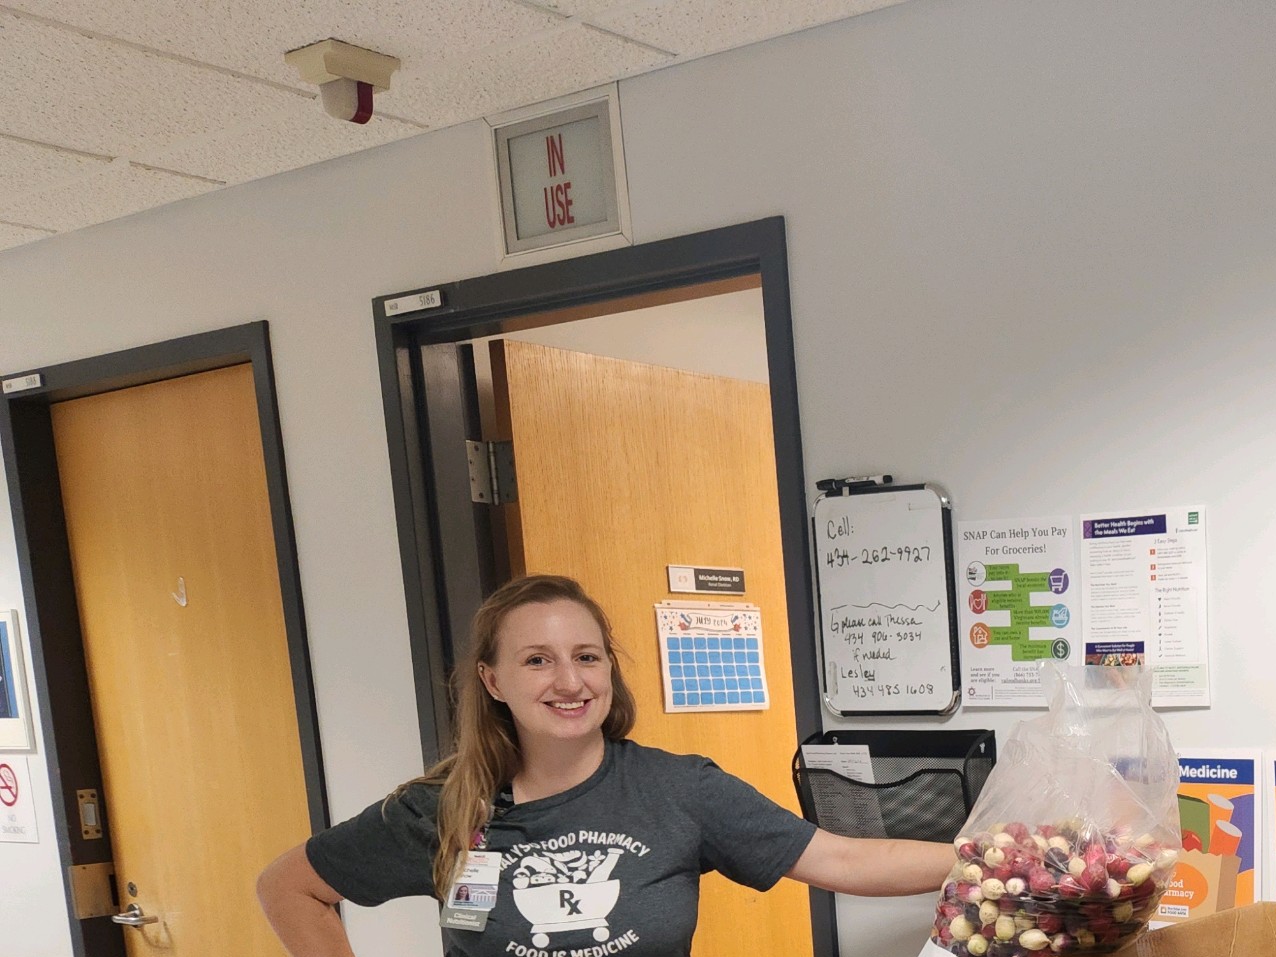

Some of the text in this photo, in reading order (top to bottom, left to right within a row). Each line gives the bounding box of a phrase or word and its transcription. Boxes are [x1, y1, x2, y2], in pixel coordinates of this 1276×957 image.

[546, 134, 565, 177] IN
[544, 182, 575, 229] USE
[827, 516, 854, 540] Cell:
[1127, 520, 1143, 528] Begins
[964, 526, 1068, 541] SNAP Can Help You Pay
[986, 544, 1046, 555] For Groceries!
[844, 632, 864, 645] 434
[841, 664, 876, 681] Lesley
[853, 685, 874, 698] 434
[1178, 766, 1238, 779] Medicine
[540, 832, 576, 851] FOOD
[578, 830, 651, 858] PHARMACY
[559, 889, 583, 916] Rx
[454, 912, 478, 920] Clinical
